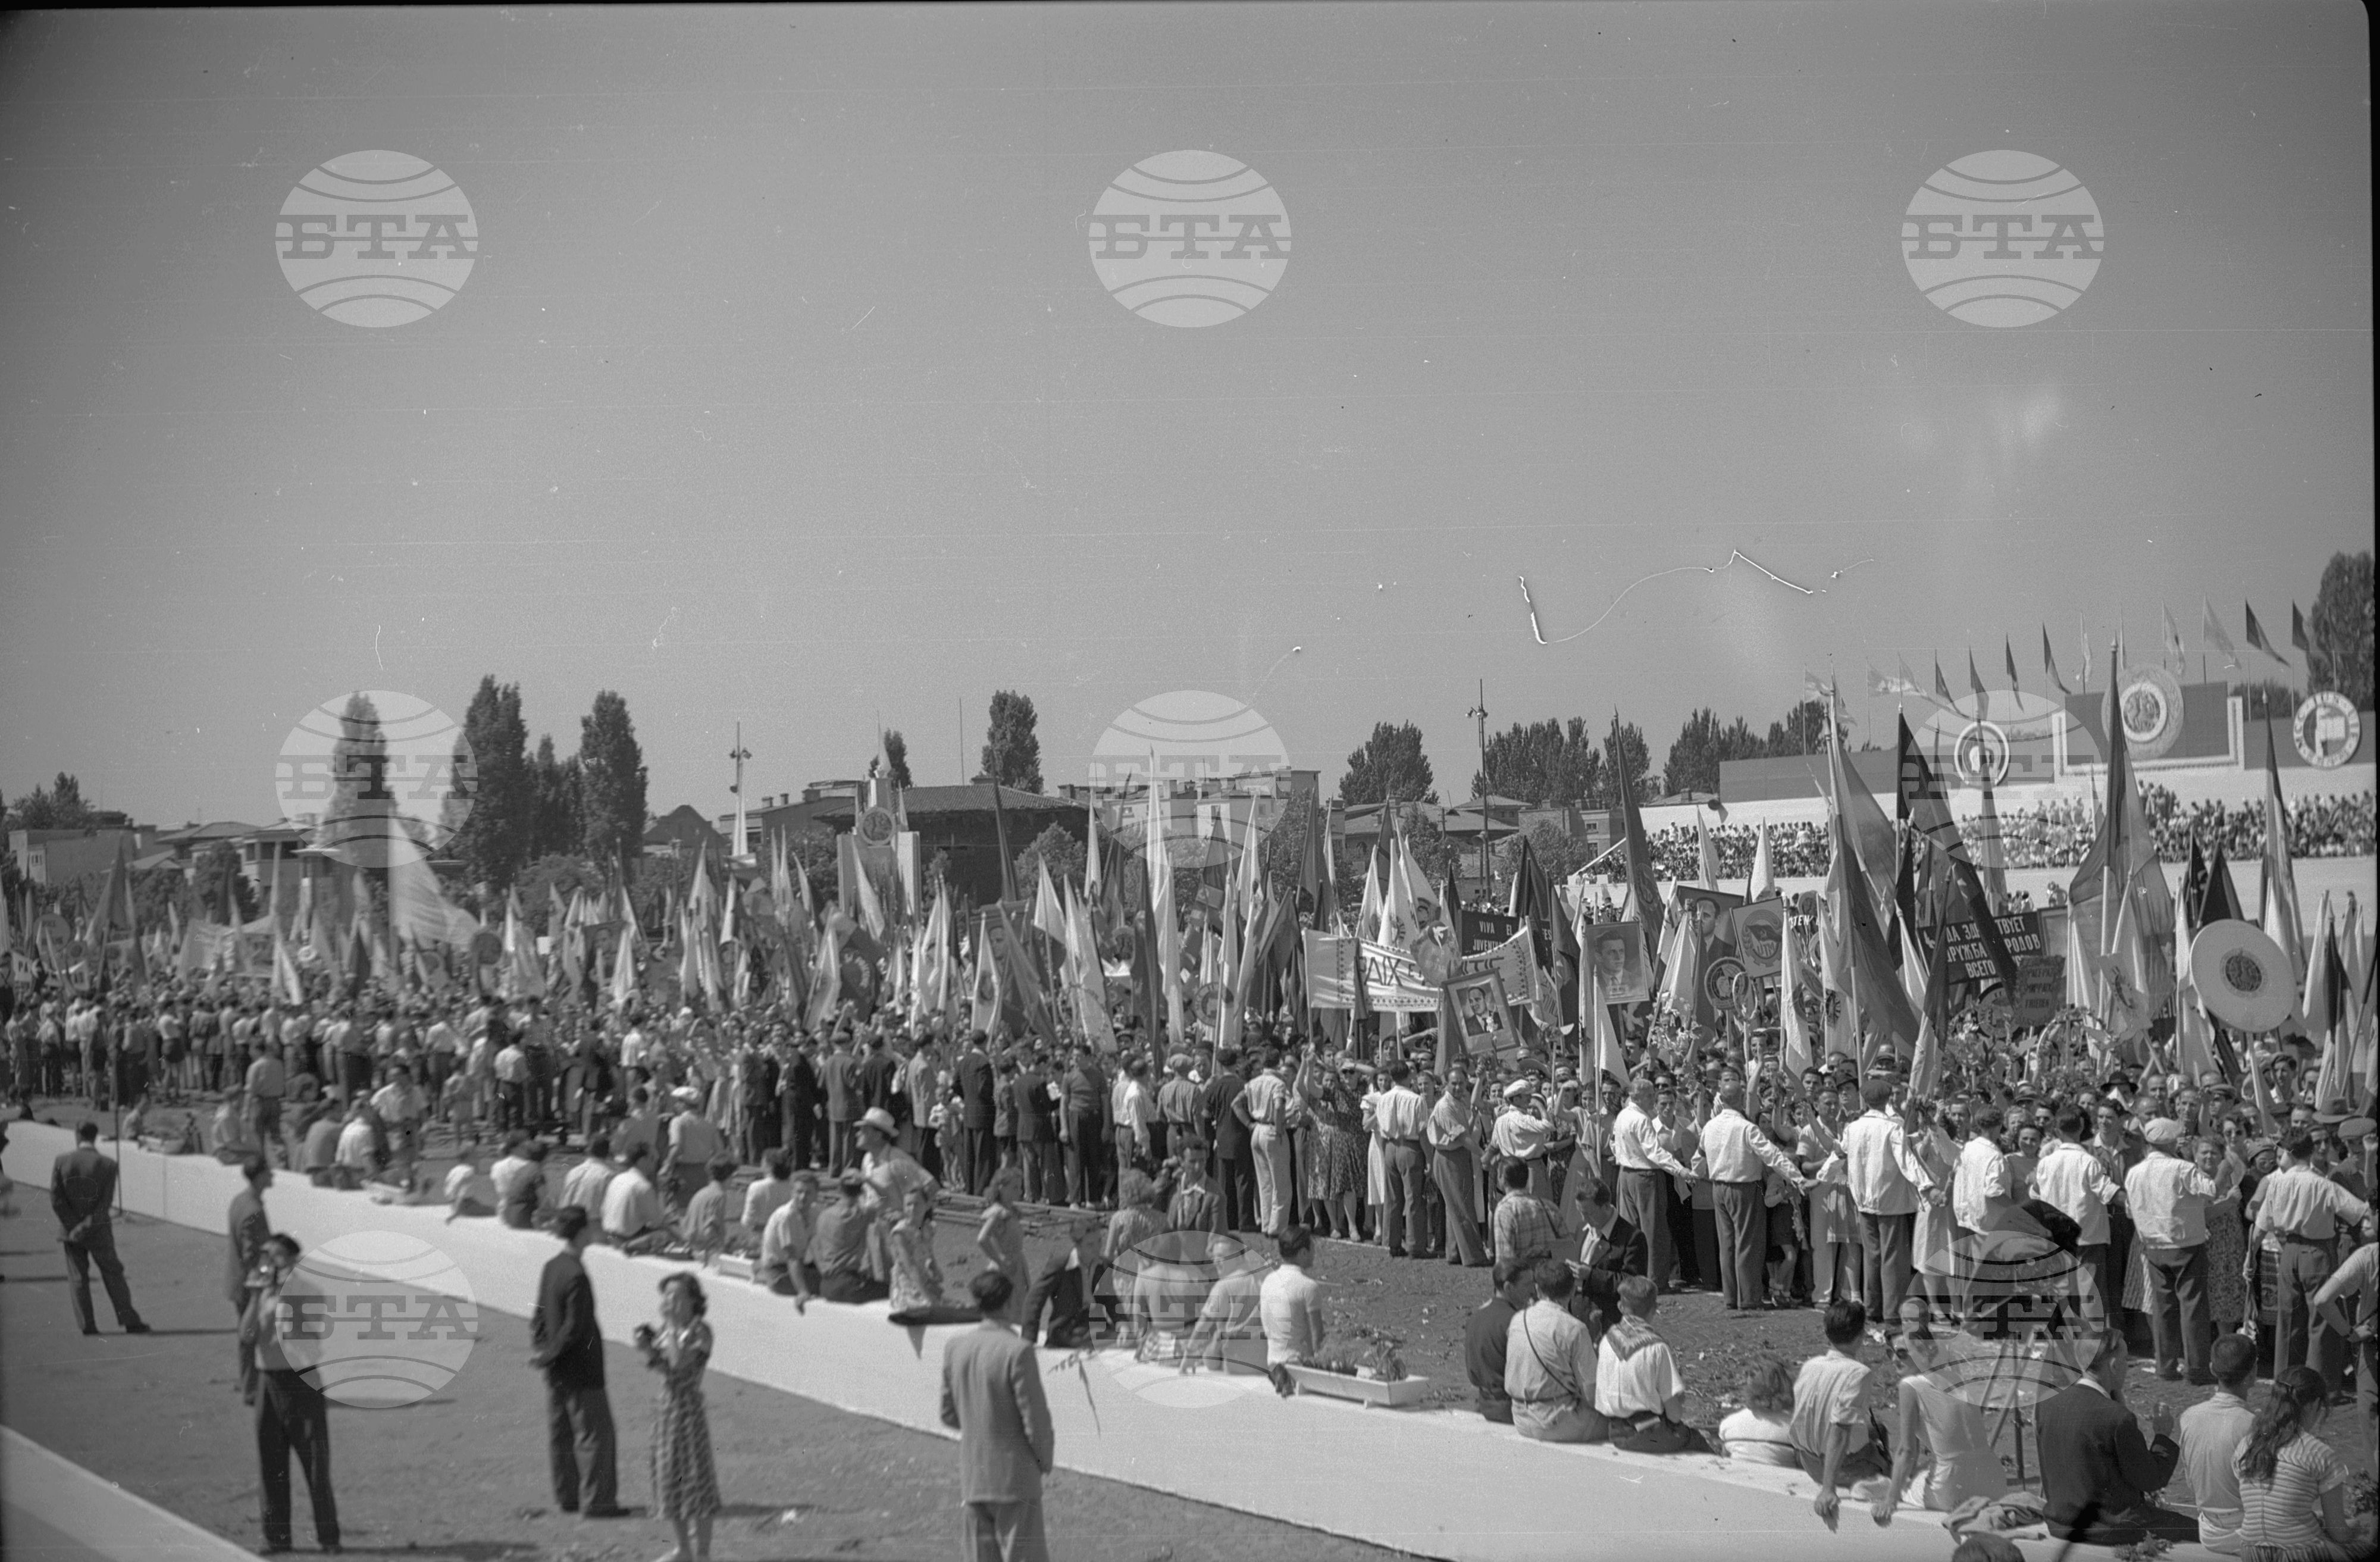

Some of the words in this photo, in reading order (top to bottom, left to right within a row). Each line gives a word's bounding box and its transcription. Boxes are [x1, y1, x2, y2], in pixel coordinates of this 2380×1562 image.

[1479, 921, 1495, 934] VIVA
[1946, 925, 1961, 943] ДА
[1965, 959, 1997, 979] ВСЕГО
